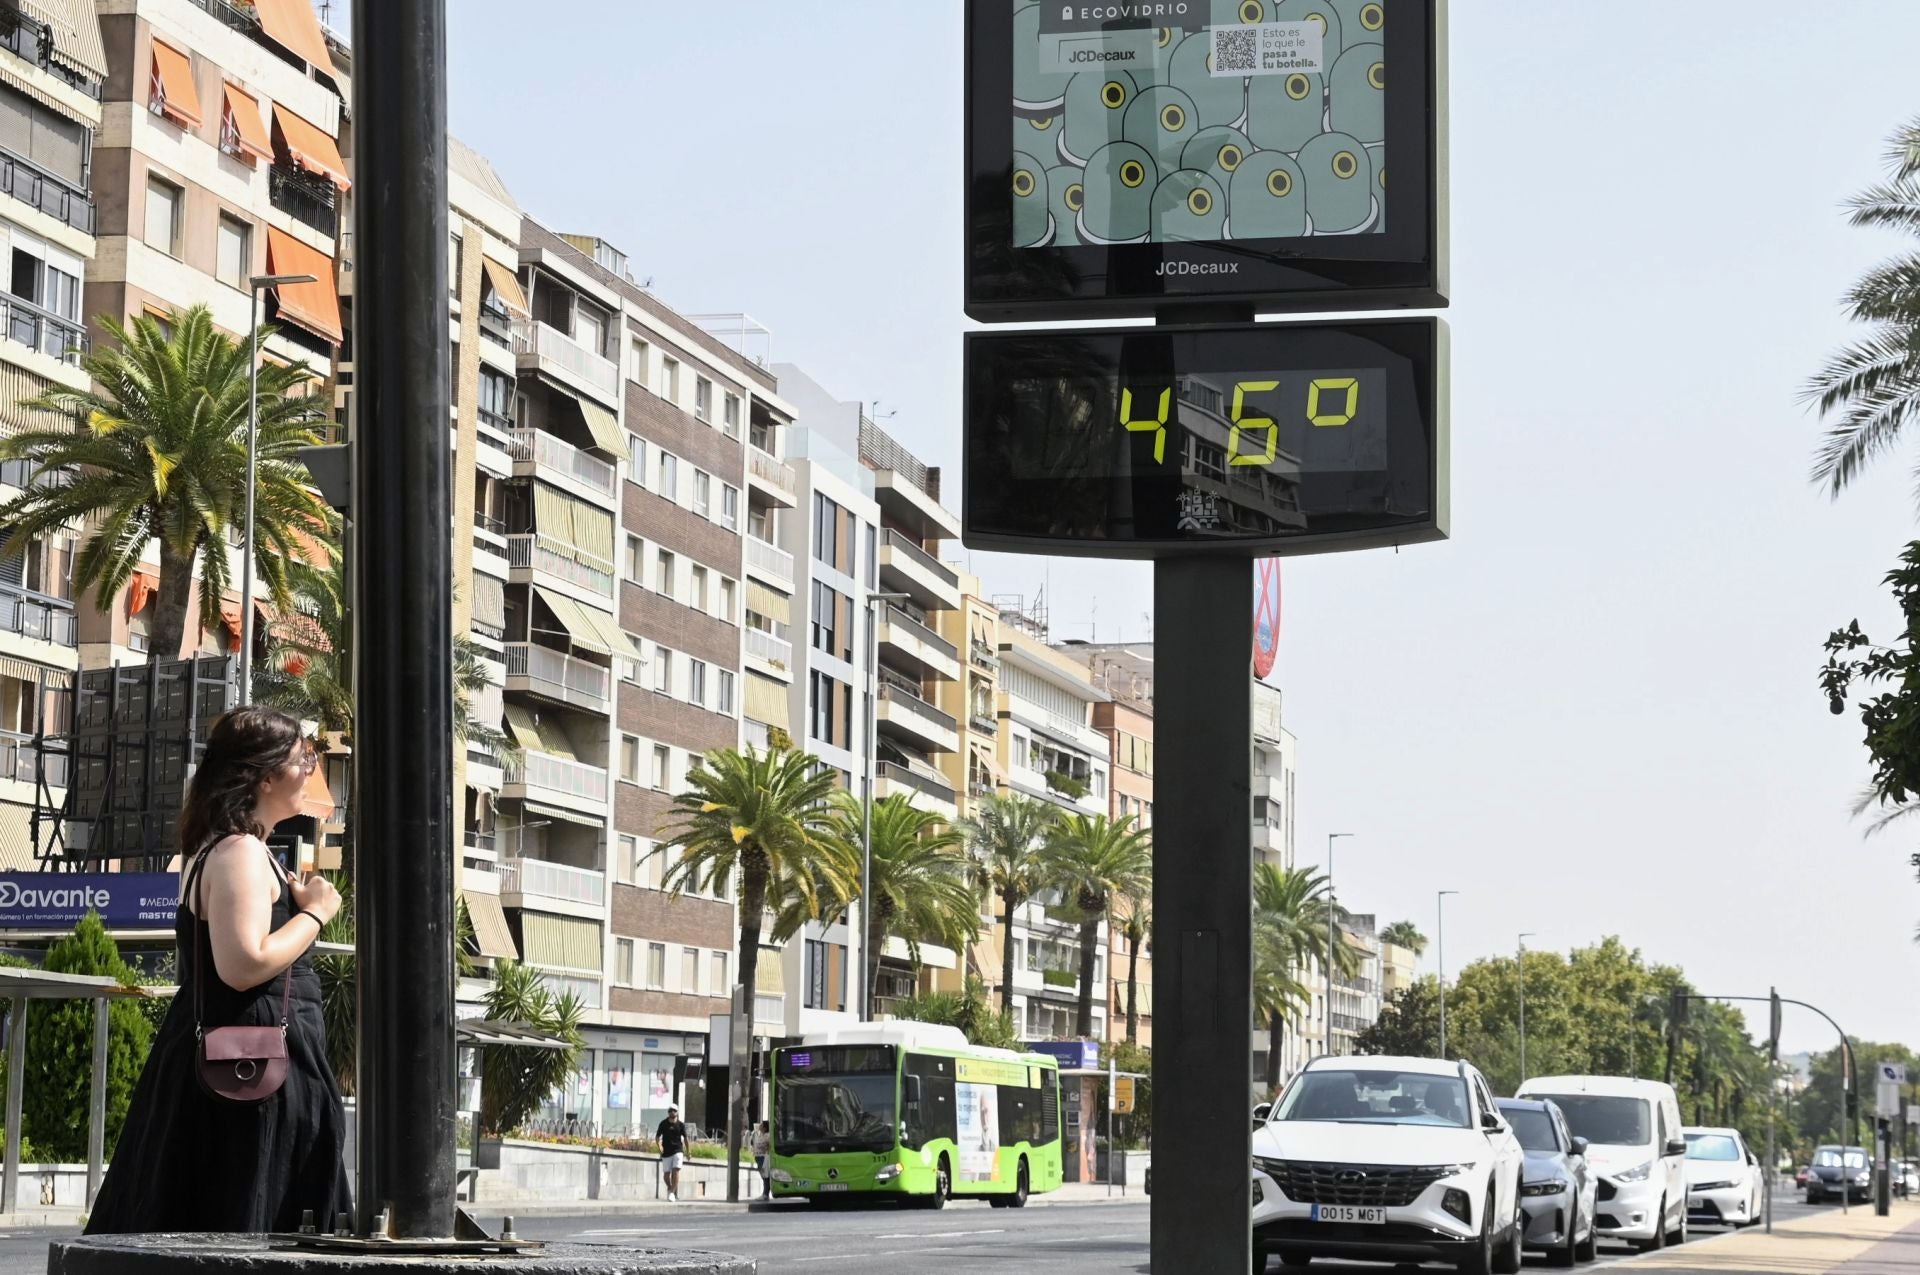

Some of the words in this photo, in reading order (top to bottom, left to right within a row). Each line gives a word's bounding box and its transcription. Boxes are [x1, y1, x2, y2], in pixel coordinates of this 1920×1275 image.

[1081, 2, 1188, 19] ECOVIDRIO
[1262, 28, 1285, 38] Esto
[1288, 29, 1300, 37] es
[1262, 39, 1272, 49] lo
[1274, 39, 1295, 50] que
[1296, 38, 1306, 47] le
[1068, 50, 1136, 63] JCDecaux
[1262, 51, 1288, 62] pasa
[1290, 50, 1297, 58] a
[1262, 60, 1274, 69] tu
[1276, 58, 1318, 69] botella.
[1155, 261, 1239, 276] JCDecaux
[1320, 1206, 1354, 1221] 0015
[1358, 1208, 1383, 1222] MGT
